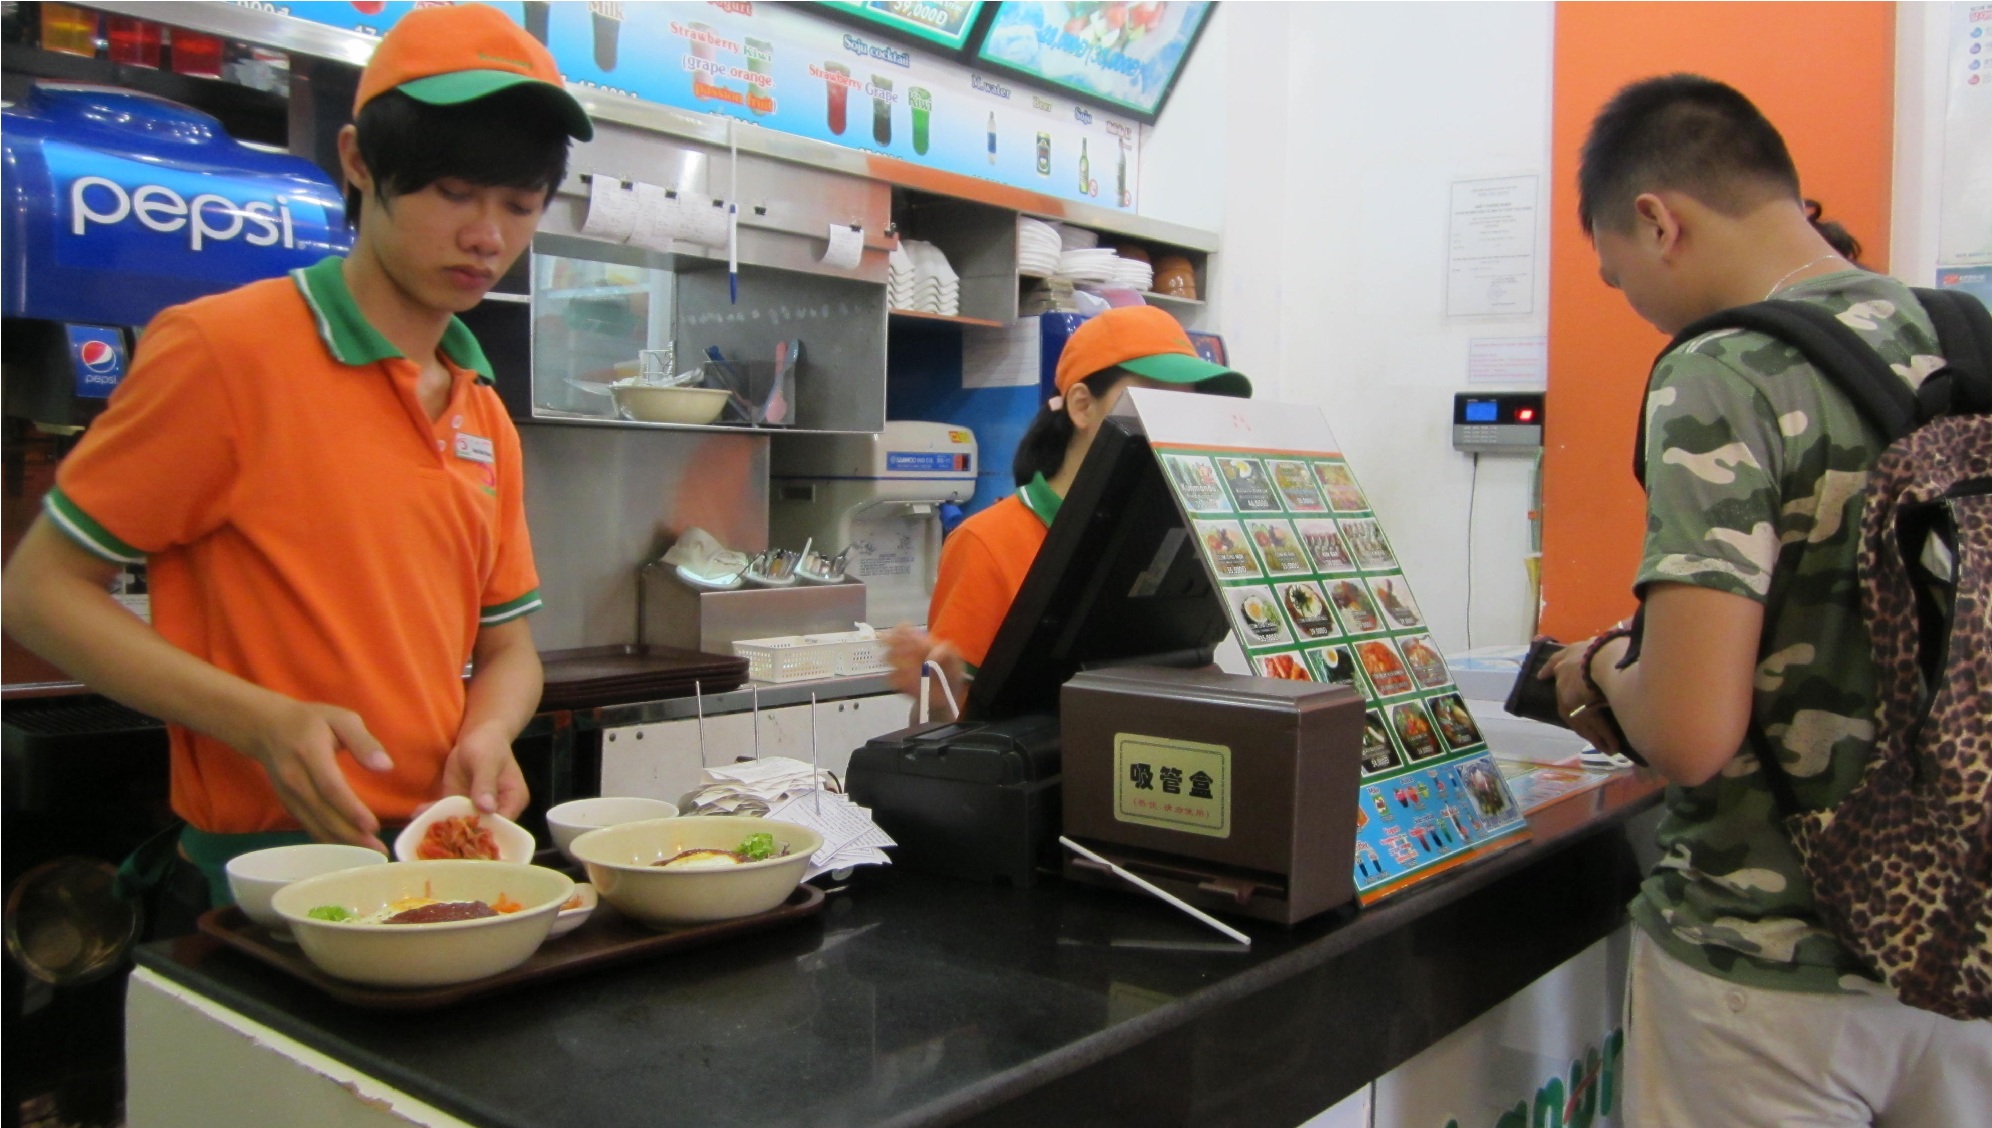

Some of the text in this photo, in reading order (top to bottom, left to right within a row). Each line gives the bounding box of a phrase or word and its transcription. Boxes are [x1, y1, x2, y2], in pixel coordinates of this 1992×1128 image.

[670, 20, 773, 63] Strawberry Kiwi
[843, 33, 910, 68] Soju cocktail
[808, 63, 863, 91] Strawberry
[865, 81, 898, 106] Grape
[908, 91, 932, 112] Kiwi
[71, 176, 294, 251] pepsi
[86, 374, 117, 385] pepsi
[1130, 762, 1213, 800] 吸管盒
